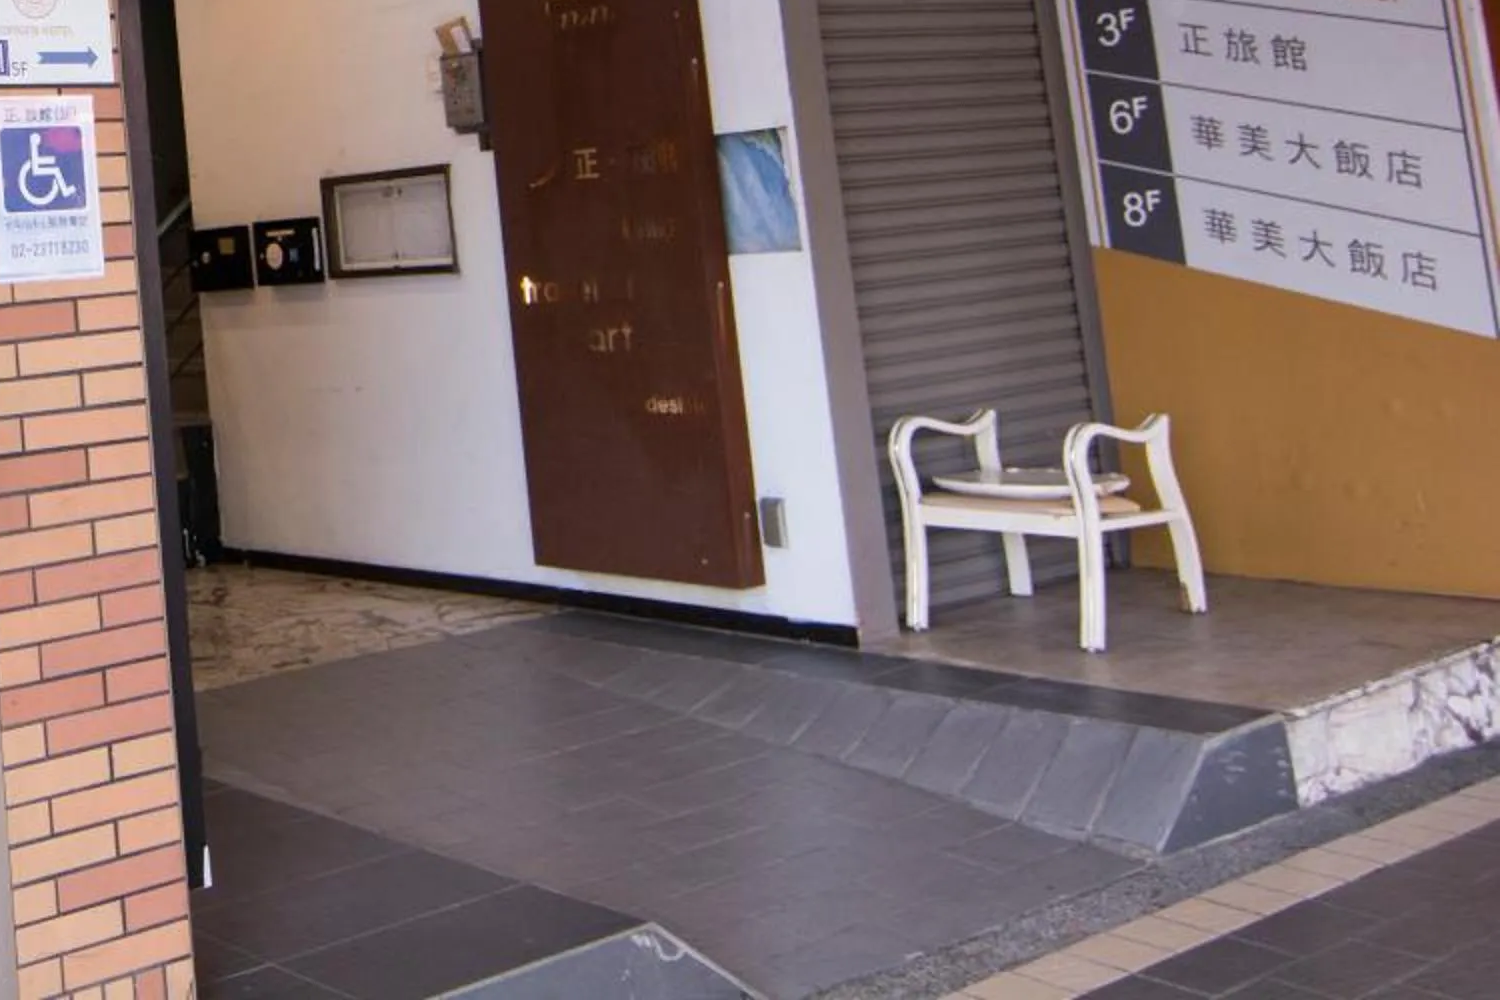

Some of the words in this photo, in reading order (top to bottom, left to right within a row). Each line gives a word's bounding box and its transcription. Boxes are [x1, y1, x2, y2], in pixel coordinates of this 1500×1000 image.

[1096, 8, 1135, 47] 3F
[1178, 22, 1308, 71] 正旅館
[1109, 96, 1148, 134] 6F
[1190, 114, 1424, 189] 華美大飯店
[1123, 189, 1162, 227] 8F
[1204, 208, 1438, 291] 華美大飯店
